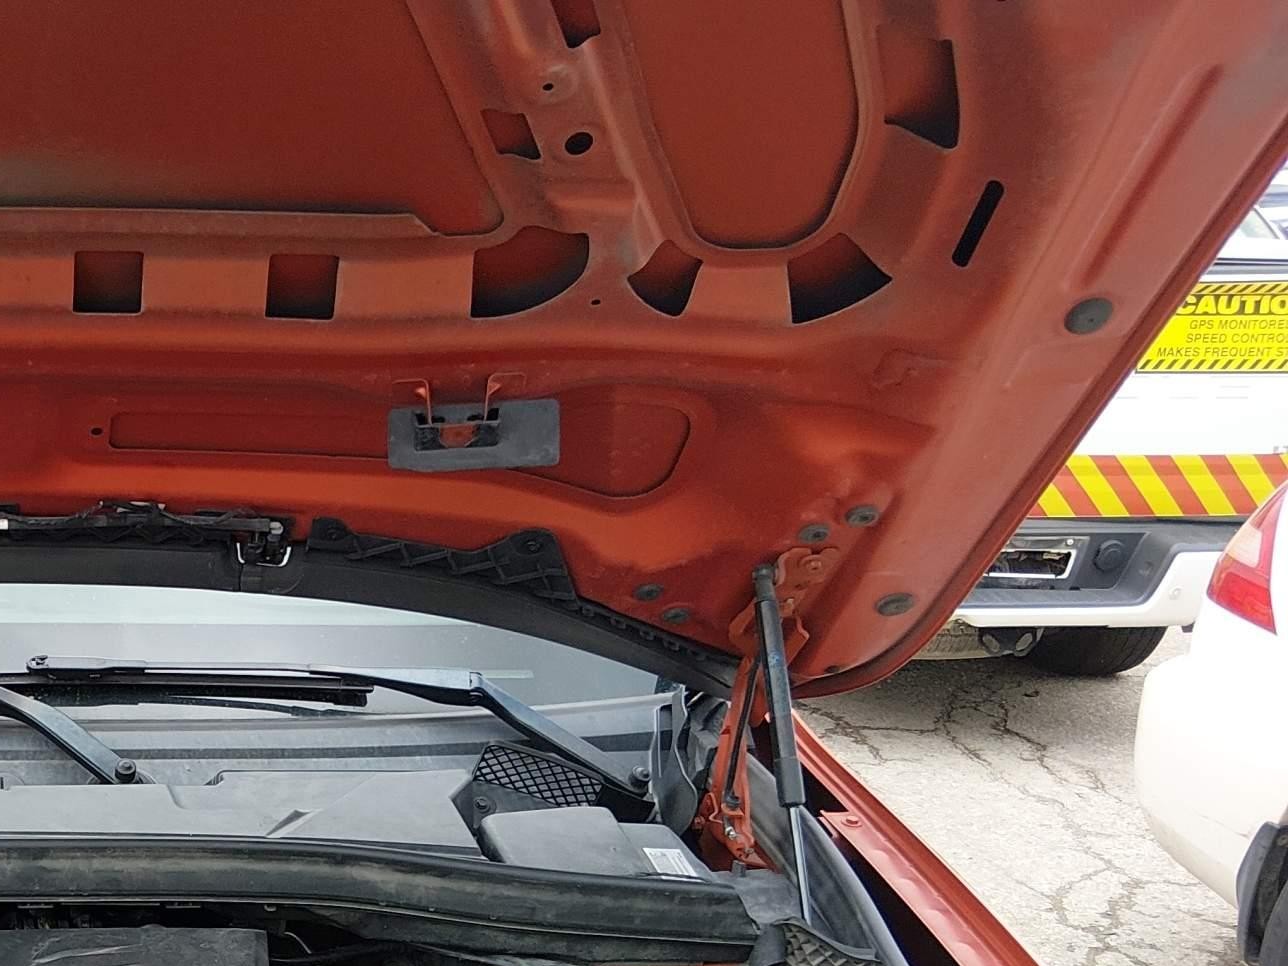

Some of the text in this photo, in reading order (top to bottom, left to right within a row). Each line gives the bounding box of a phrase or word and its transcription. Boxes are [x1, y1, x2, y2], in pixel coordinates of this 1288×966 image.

[1189, 320, 1288, 330] GPS MONITORE
[1186, 333, 1288, 344] SPEED CONTRO
[1157, 347, 1200, 357] MAKES
[1204, 347, 1271, 357] FREQUENT
